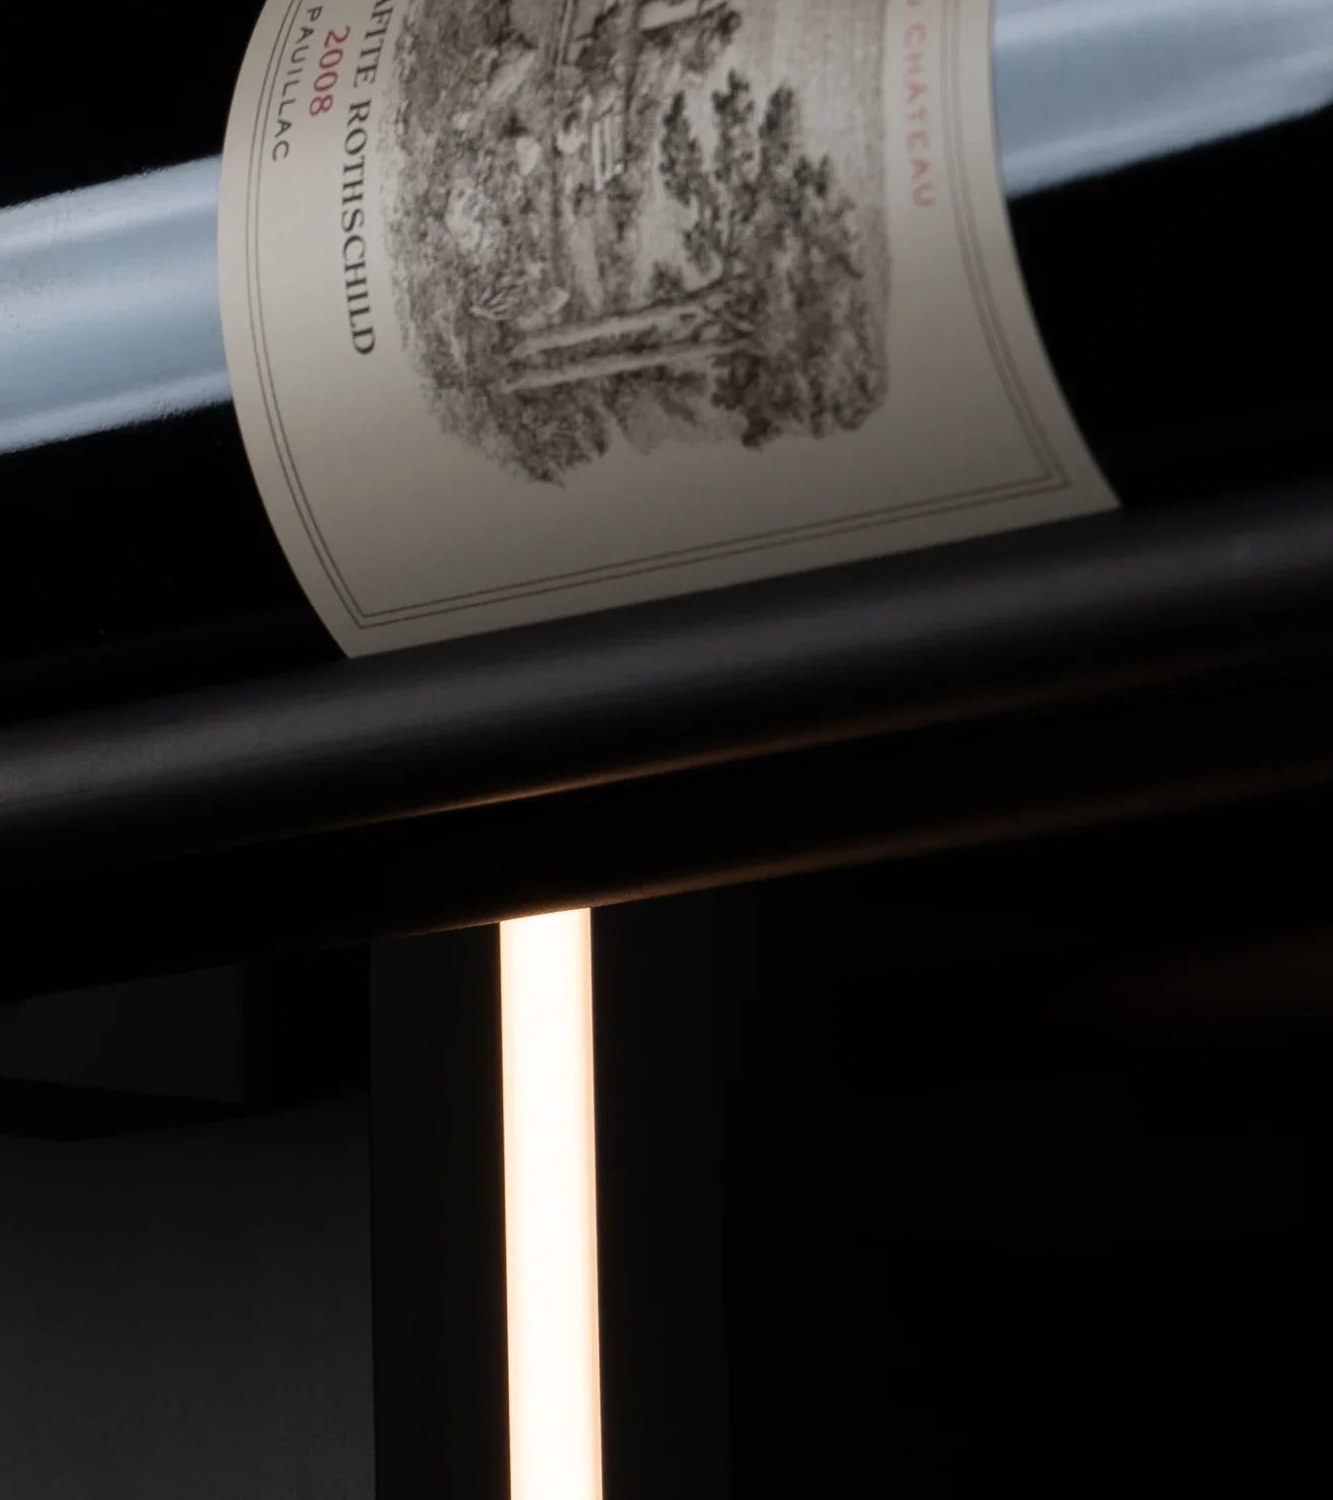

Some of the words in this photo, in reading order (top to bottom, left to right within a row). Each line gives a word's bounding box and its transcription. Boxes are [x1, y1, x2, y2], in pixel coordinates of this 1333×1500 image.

[270, 4, 324, 163] PAUILLAC
[307, 24, 352, 118] 2008
[340, 95, 377, 358] ROTHSCHILD
